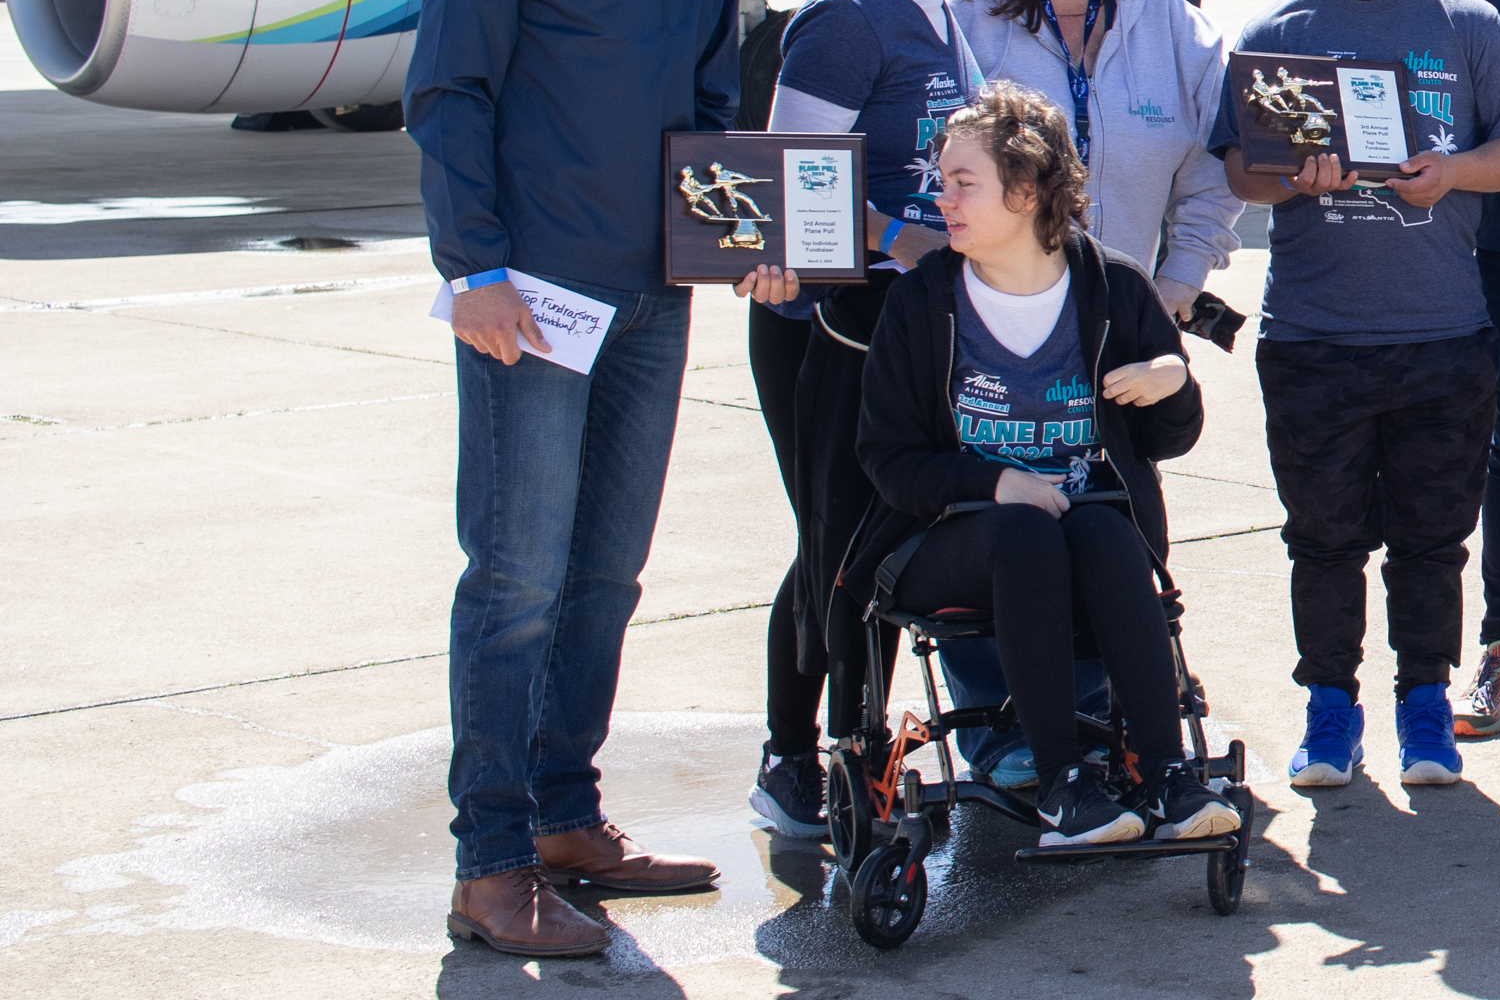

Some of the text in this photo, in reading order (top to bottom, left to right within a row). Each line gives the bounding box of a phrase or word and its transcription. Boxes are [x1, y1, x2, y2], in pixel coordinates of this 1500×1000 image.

[1417, 70, 1458, 82] RESOURCE
[929, 89, 958, 97] AIRLINES
[926, 99, 942, 109] 3rd
[1128, 98, 1163, 120] alpha
[798, 165, 820, 173] PLANE
[518, 289, 603, 335] Top Fundraising
[964, 386, 1004, 400] AIRLINES
[1045, 374, 1093, 405] alpha
[958, 393, 1010, 413] 3rd Annual
[1068, 398, 1095, 408] RESOU
[998, 446, 1053, 460] 2024
